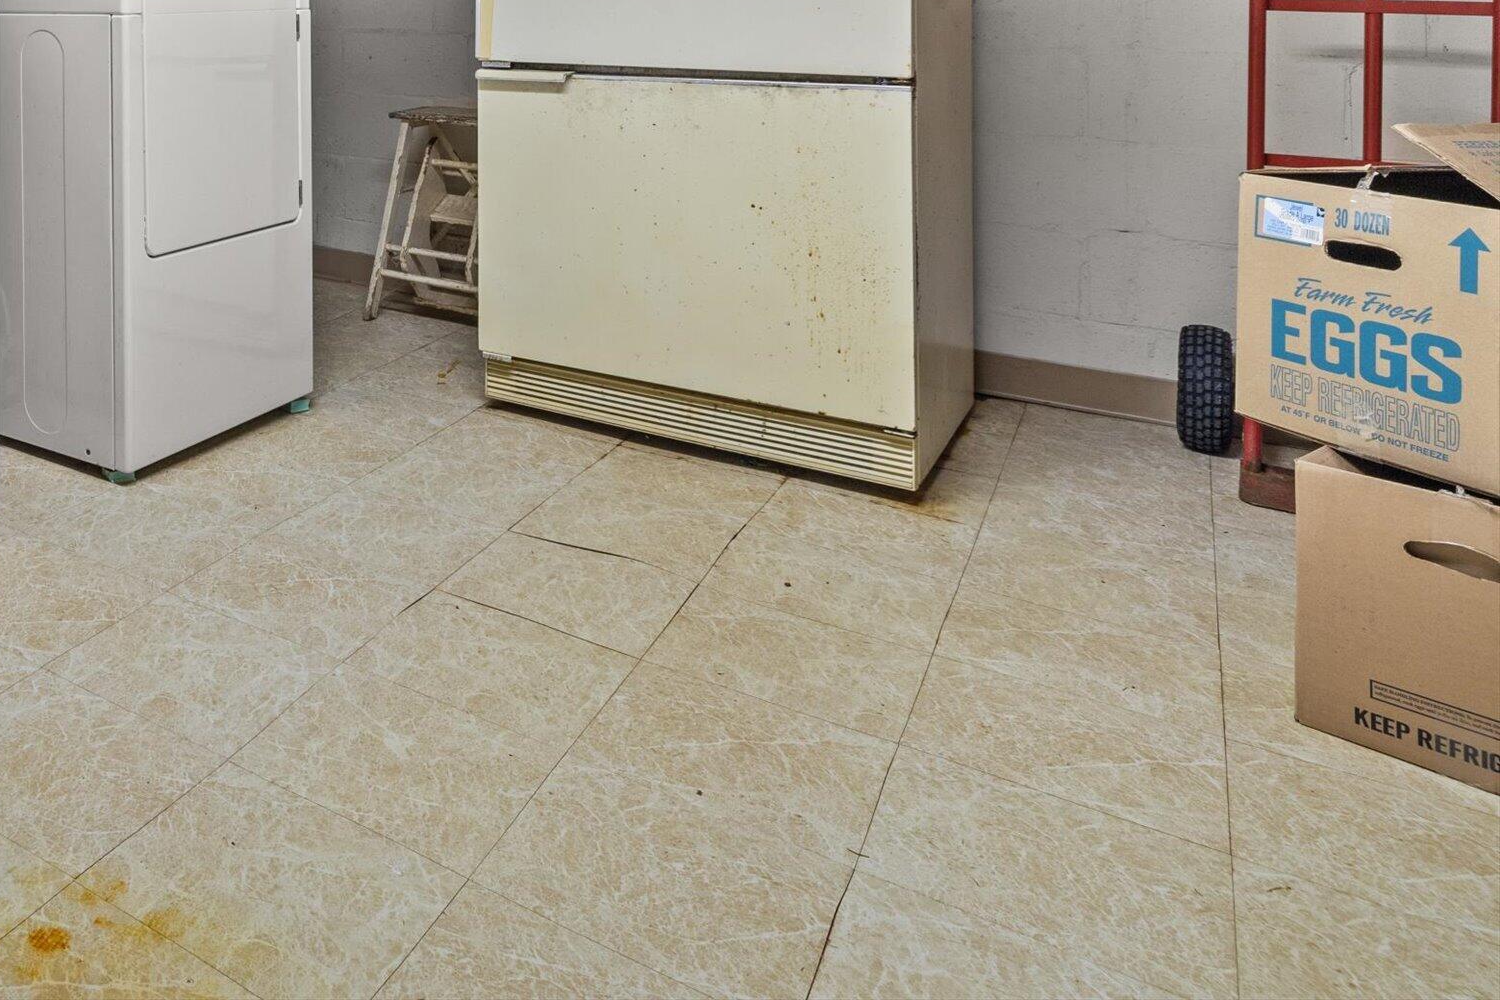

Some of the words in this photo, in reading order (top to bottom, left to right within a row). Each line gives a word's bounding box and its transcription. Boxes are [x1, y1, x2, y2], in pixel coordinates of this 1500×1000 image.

[1334, 208, 1349, 229] 30
[1353, 210, 1391, 236] DOZEN
[1293, 277, 1356, 308] Farm
[1361, 291, 1434, 325] Fresh
[1271, 298, 1462, 404] EGGS
[1270, 363, 1313, 407] KEEP
[1317, 376, 1461, 452] REFRIGERATED
[1281, 404, 1292, 413] AT
[1313, 414, 1327, 424] OR
[1328, 418, 1361, 435] BELOW
[1387, 436, 1409, 448] NOT
[1410, 443, 1450, 462] FREEZE
[1354, 706, 1411, 740] KEEP
[1417, 728, 1500, 774] REFRIG
